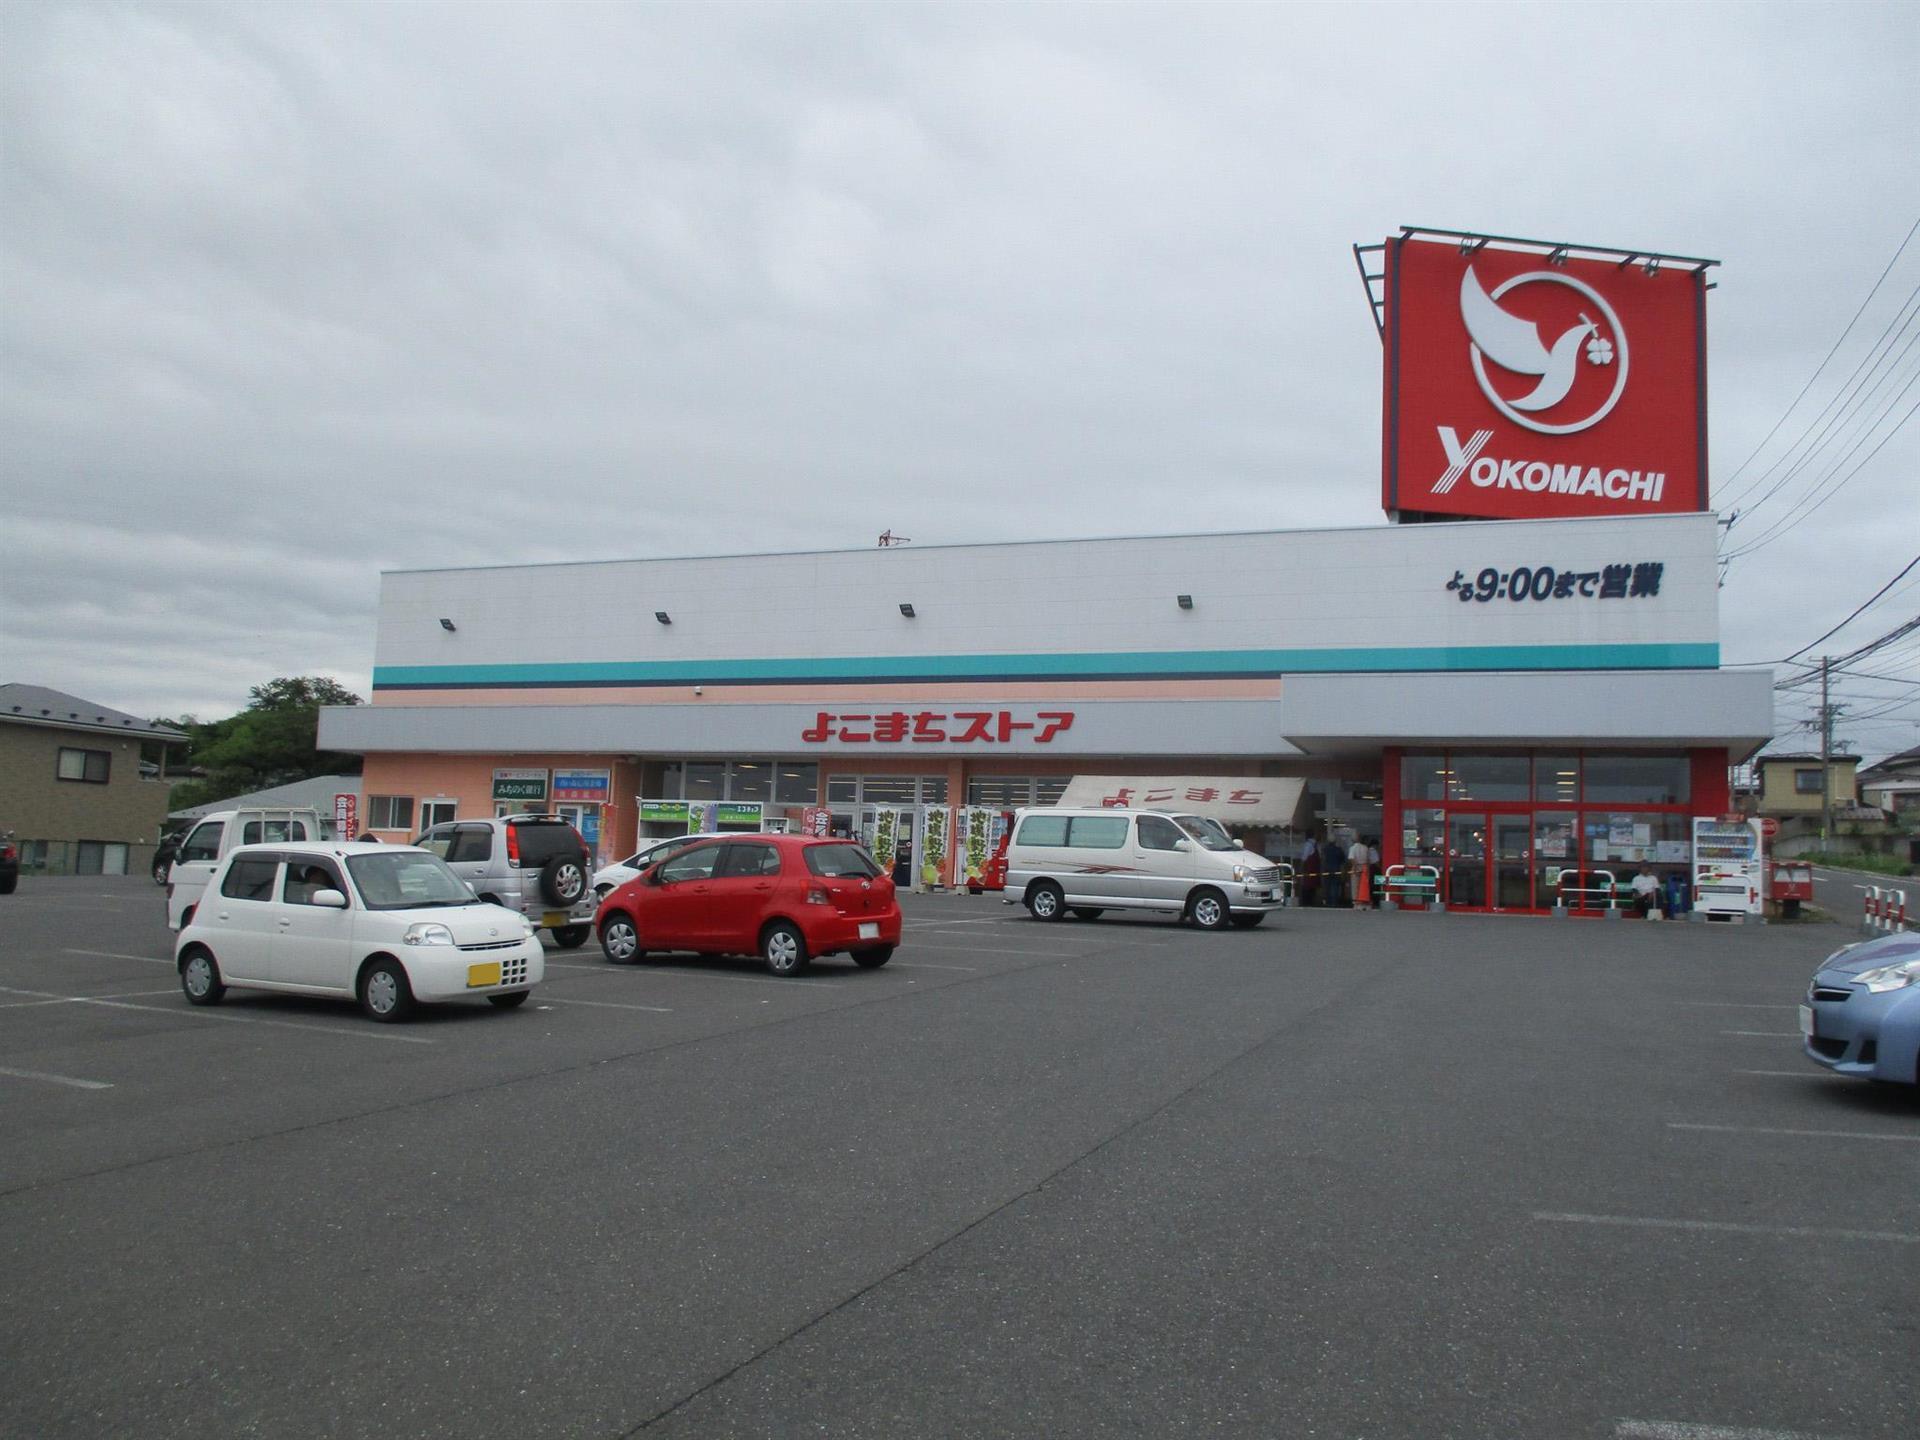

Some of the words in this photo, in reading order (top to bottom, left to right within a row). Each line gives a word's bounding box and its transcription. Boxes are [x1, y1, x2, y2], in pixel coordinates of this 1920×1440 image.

[1430, 425, 1665, 503] YOKOMACHI
[1446, 562, 1664, 602] よる9:00まで営業
[802, 712, 1075, 743] よこまちストア
[498, 784, 541, 795] みちのく銀行
